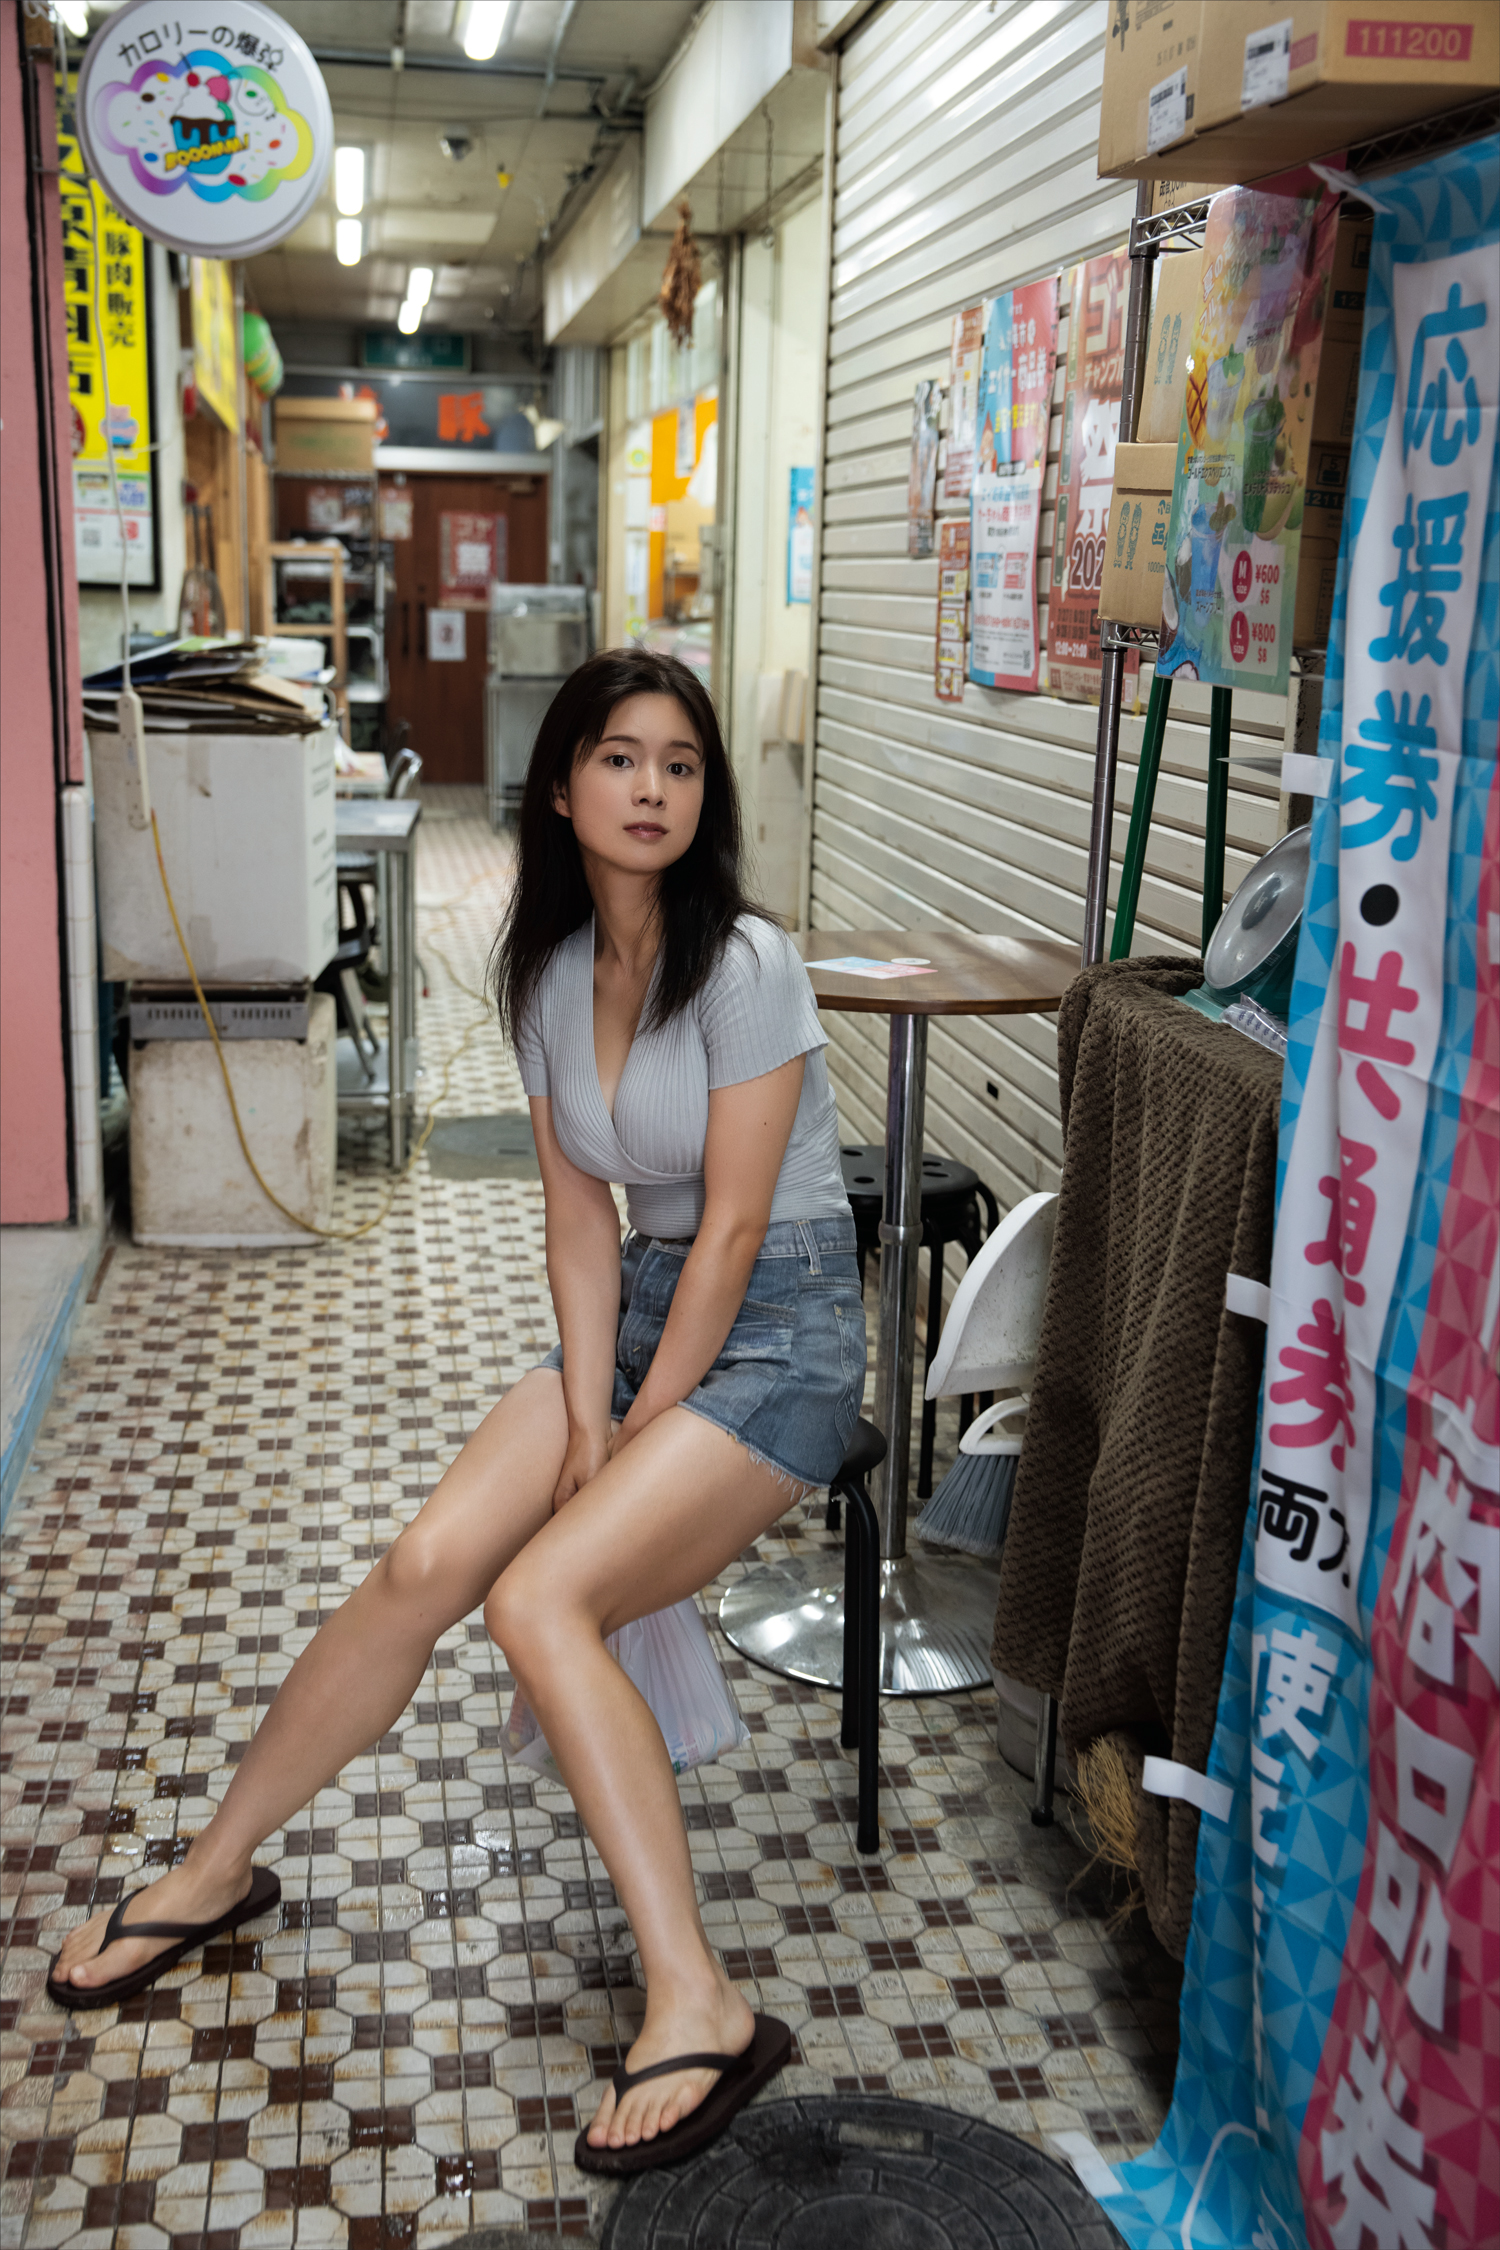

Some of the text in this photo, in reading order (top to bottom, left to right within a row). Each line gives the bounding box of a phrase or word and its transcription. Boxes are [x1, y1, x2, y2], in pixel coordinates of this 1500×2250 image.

[1361, 27, 1461, 57] 111200
[1084, 354, 1124, 388] チャンプル
[1305, 491, 1344, 508] 1211
[1068, 536, 1107, 590] 202
[1147, 561, 1165, 573] 1000m
[1238, 560, 1280, 584] M ¥600
[1236, 582, 1247, 595] size
[1260, 587, 1270, 606] $6
[1236, 620, 1276, 644] L ¥800
[1233, 641, 1268, 664] size $8
